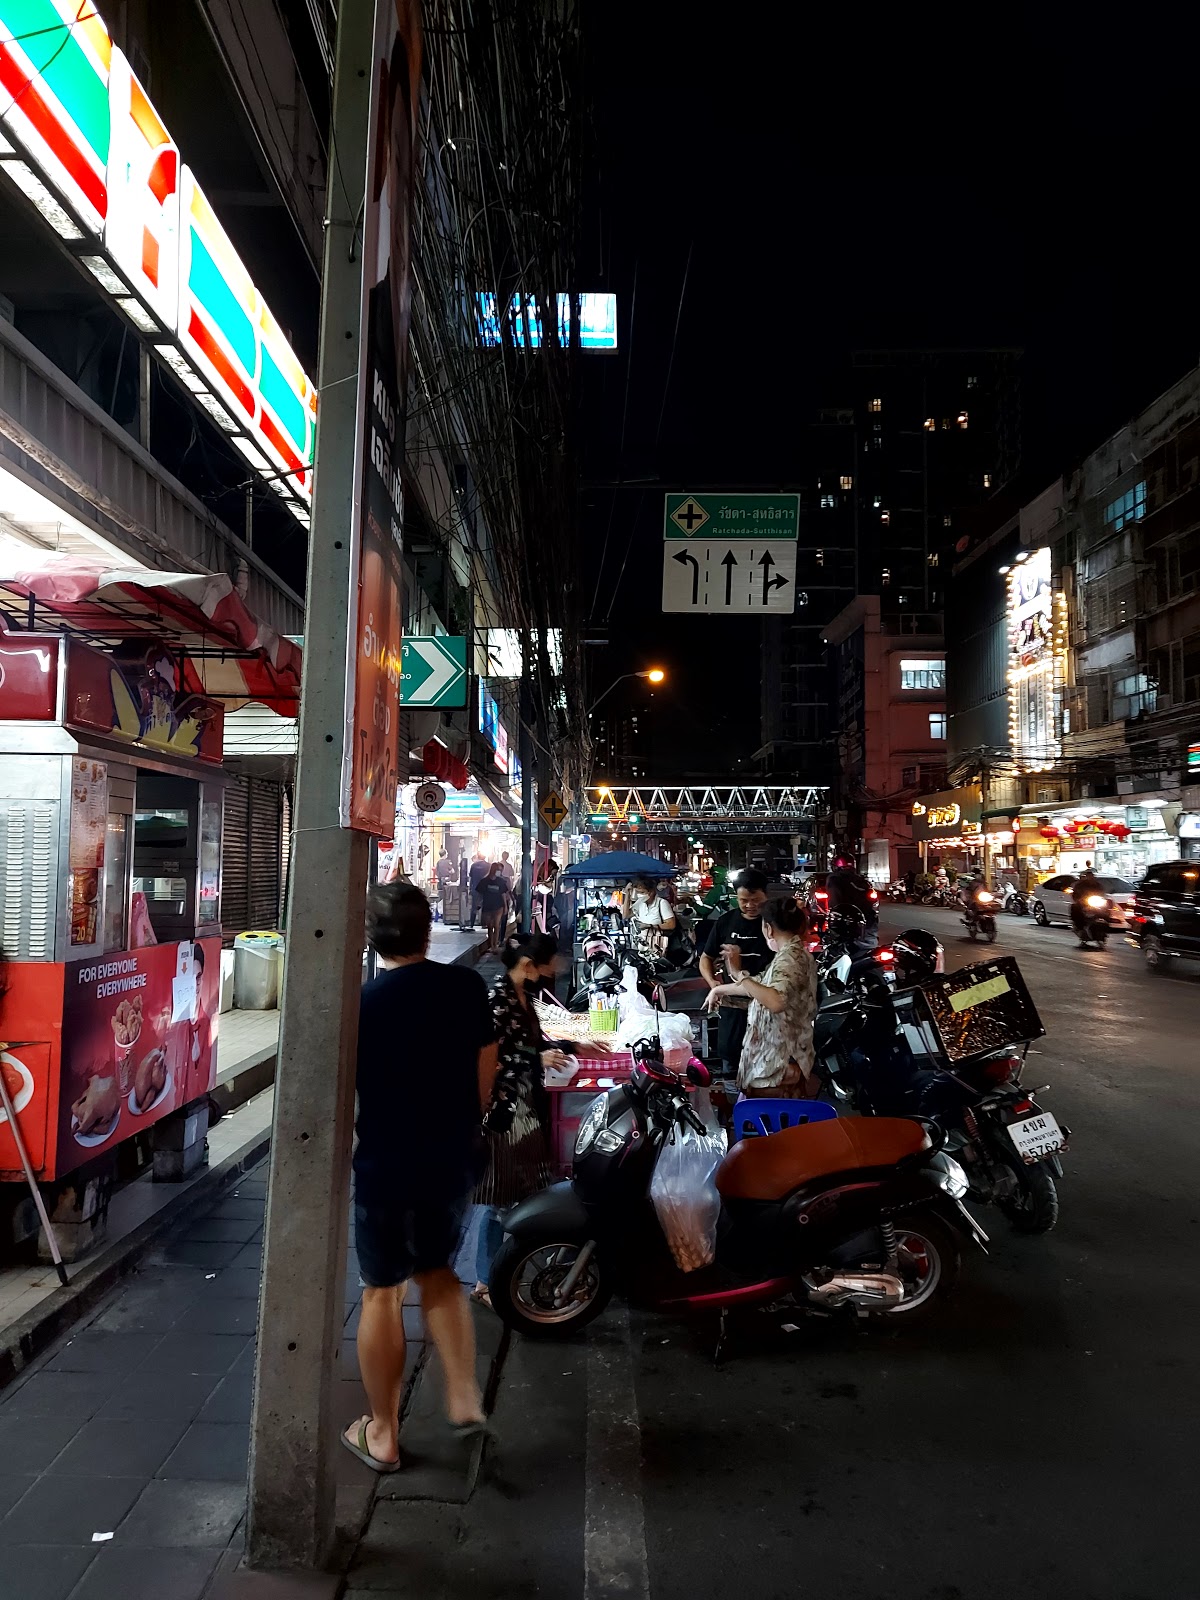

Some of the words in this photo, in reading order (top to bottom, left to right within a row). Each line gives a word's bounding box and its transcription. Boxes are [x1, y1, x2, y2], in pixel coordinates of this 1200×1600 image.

[712, 527, 793, 535] Ratchada-Sutthisan
[78, 966, 97, 984] FOR
[97, 957, 138, 979] EVERYONE
[96, 972, 147, 999] EVERYWHERE
[1029, 1140, 1059, 1157] 5762
